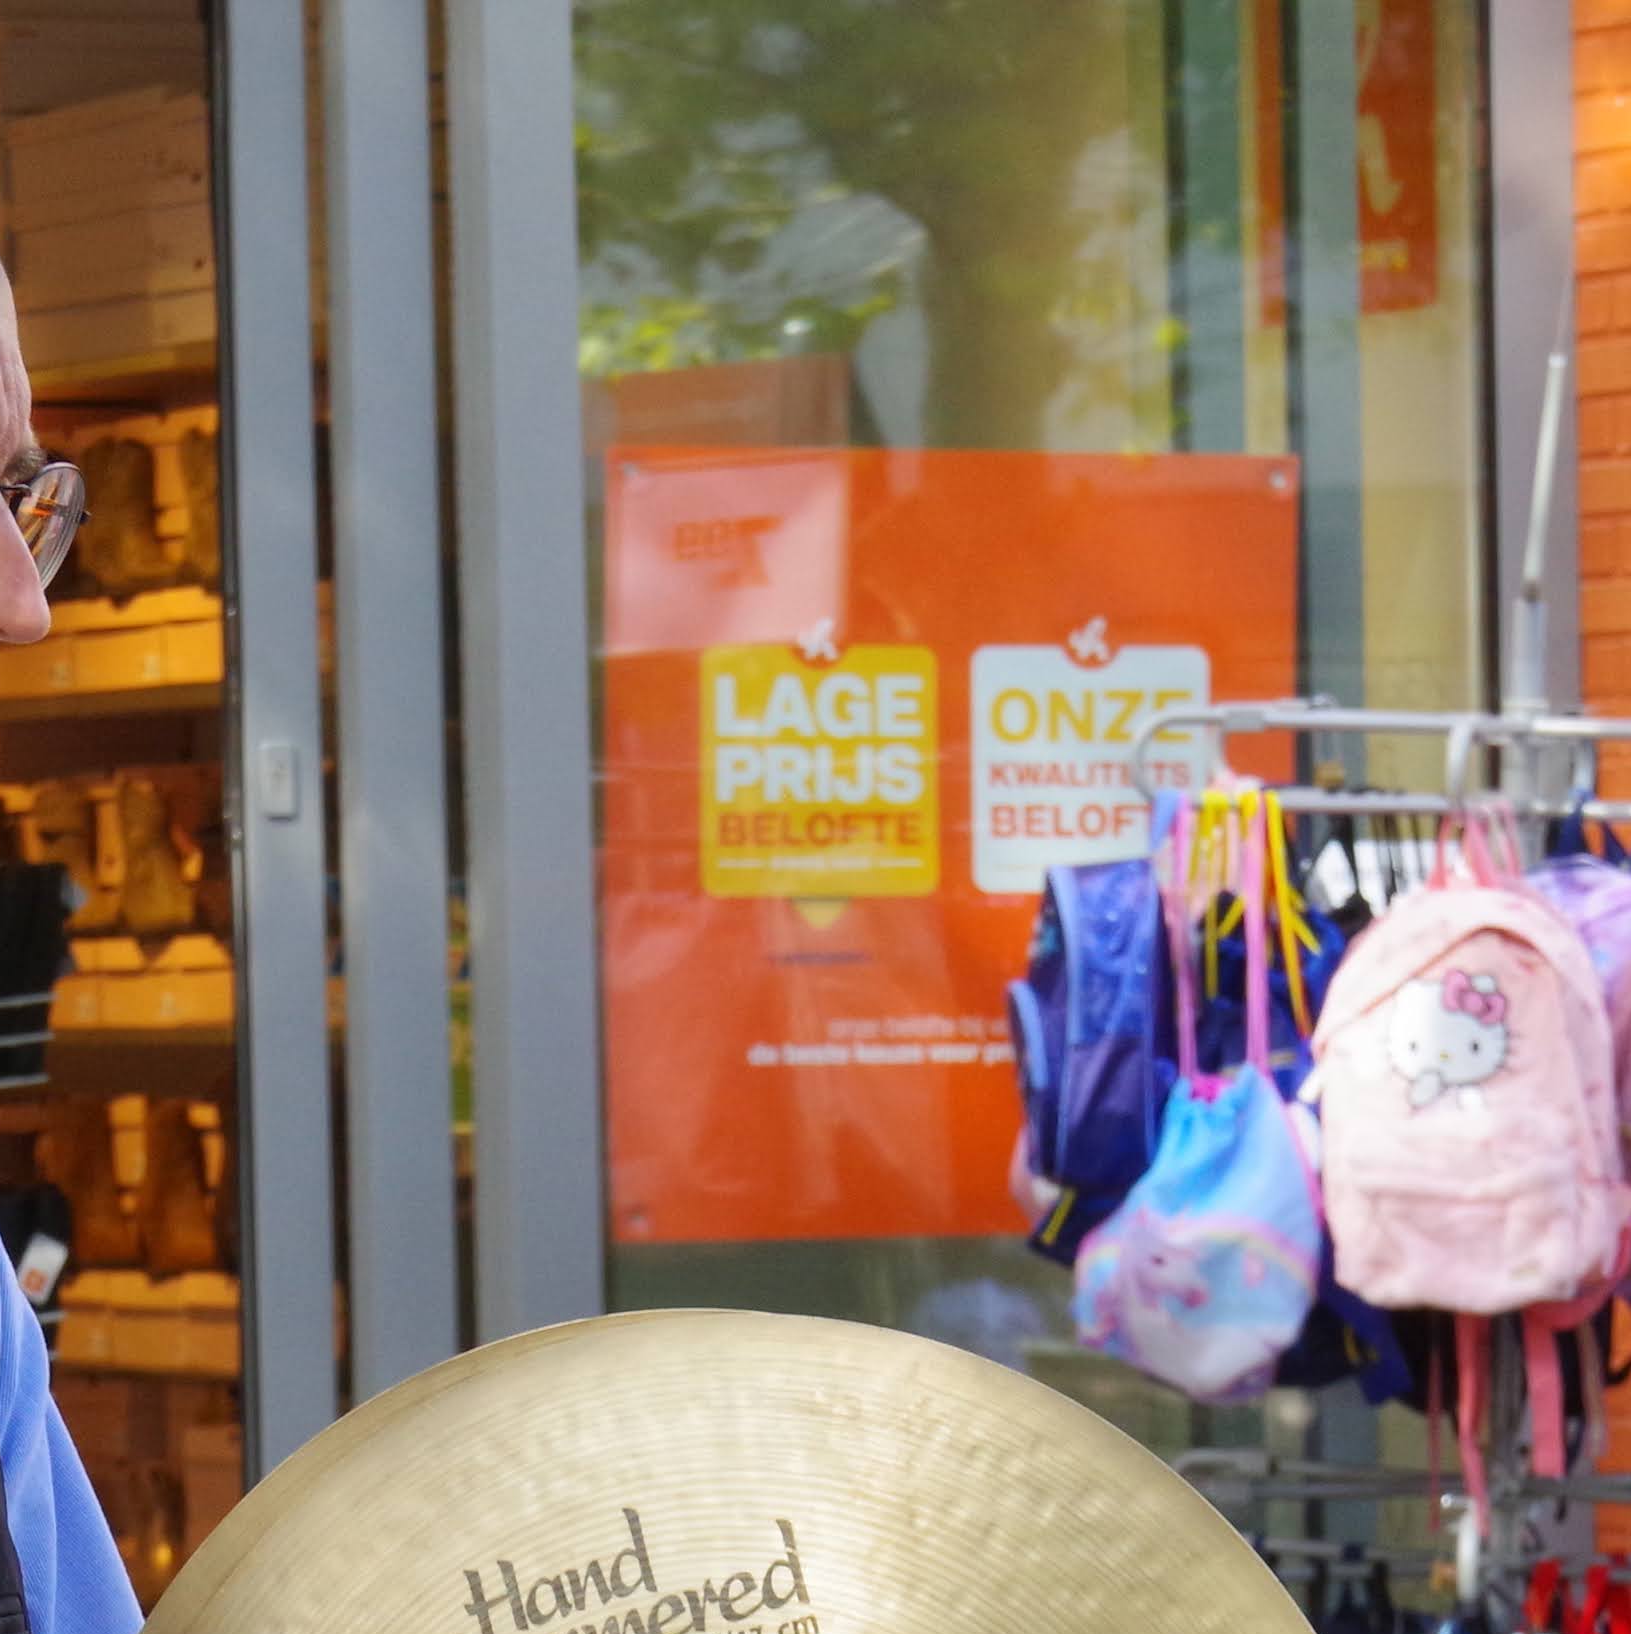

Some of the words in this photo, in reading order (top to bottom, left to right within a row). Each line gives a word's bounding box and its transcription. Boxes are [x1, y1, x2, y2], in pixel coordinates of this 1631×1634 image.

[713, 673, 925, 740] LAGE
[989, 687, 1193, 744] ONZE
[714, 744, 926, 804] PRIJS
[988, 761, 1192, 788] KWALITETS
[719, 811, 924, 848] BELOFTE
